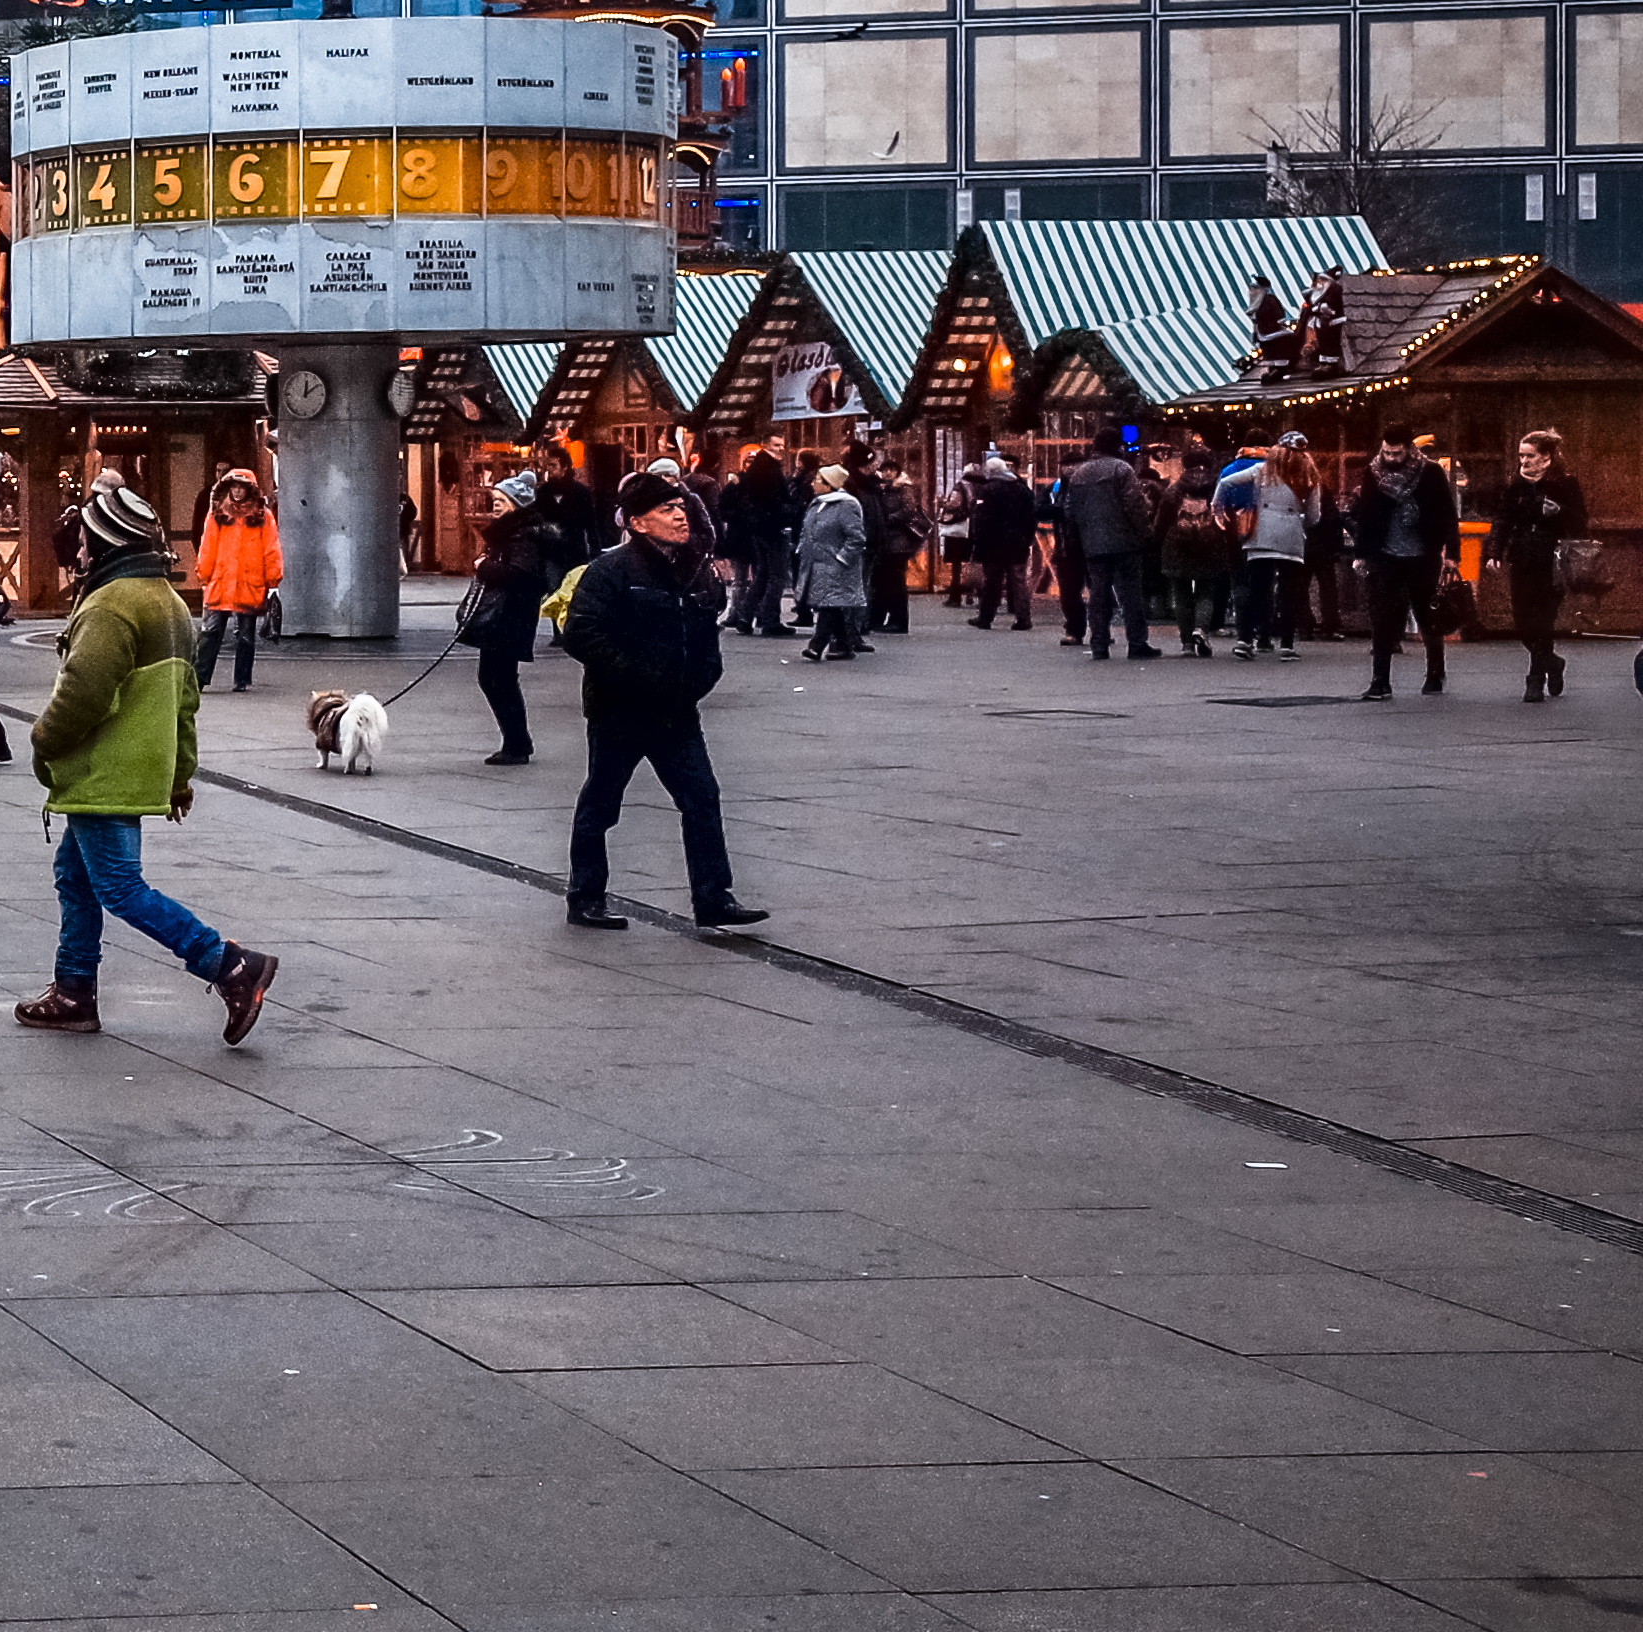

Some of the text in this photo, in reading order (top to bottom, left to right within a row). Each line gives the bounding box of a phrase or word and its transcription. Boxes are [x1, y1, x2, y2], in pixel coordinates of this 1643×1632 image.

[230, 50, 281, 60] MONTREAL
[326, 48, 369, 57] HALIFAX
[222, 70, 288, 81] WASHINGTON
[230, 82, 281, 92] NEW YORK
[231, 103, 279, 113] HAVANNA
[52, 170, 67, 216] 3
[87, 164, 116, 210] 4
[153, 158, 183, 206] 5
[228, 153, 265, 203] 6
[310, 149, 353, 199] 7
[401, 148, 439, 199] 8
[485, 149, 516, 199] 9
[546, 151, 594, 201] 10
[419, 240, 464, 249] BRASILIA
[235, 254, 276, 263] PANAMA
[326, 252, 371, 261] CARACAS
[173, 267, 198, 276] STADT
[331, 263, 343, 272] LA
[243, 275, 268, 284] QUITO
[244, 285, 266, 294] LIMA
[409, 282, 472, 291] BUENOS AIRES
[150, 288, 192, 297] MANAGUA
